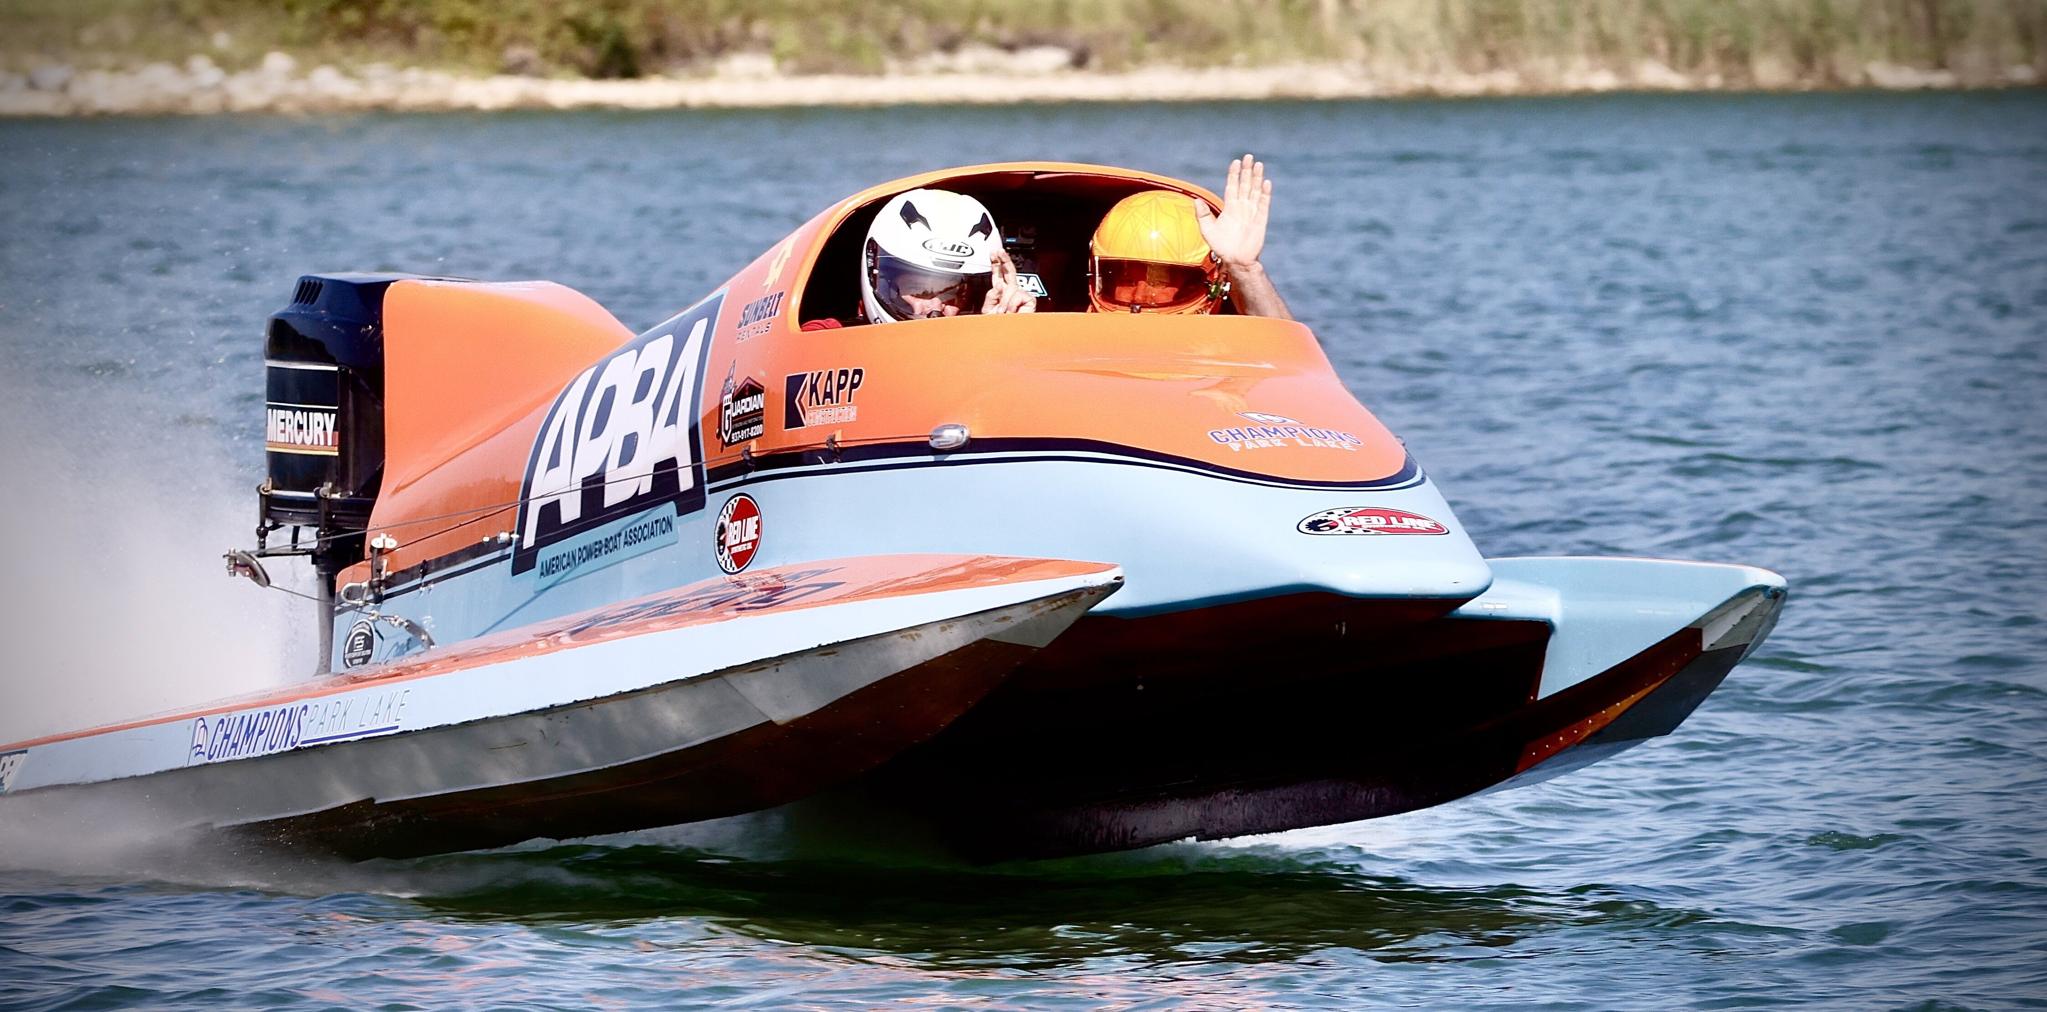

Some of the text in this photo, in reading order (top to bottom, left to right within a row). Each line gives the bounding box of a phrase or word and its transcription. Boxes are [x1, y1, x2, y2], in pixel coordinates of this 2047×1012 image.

[737, 291, 784, 329] SUNBELT
[808, 367, 864, 407] KAPP
[266, 408, 336, 447] MERCURY
[522, 317, 709, 551] APBA
[1208, 426, 1363, 446] CHAMPIONS
[1229, 437, 1358, 452] PARK LAKE
[729, 515, 760, 547] RED LINE
[1342, 515, 1387, 527] RED
[1388, 515, 1438, 531] LINE
[539, 514, 674, 579] AMERICAN POWER BOAT ASSOCIATION
[207, 689, 411, 761] CHAMPIONS PARK LAKE
